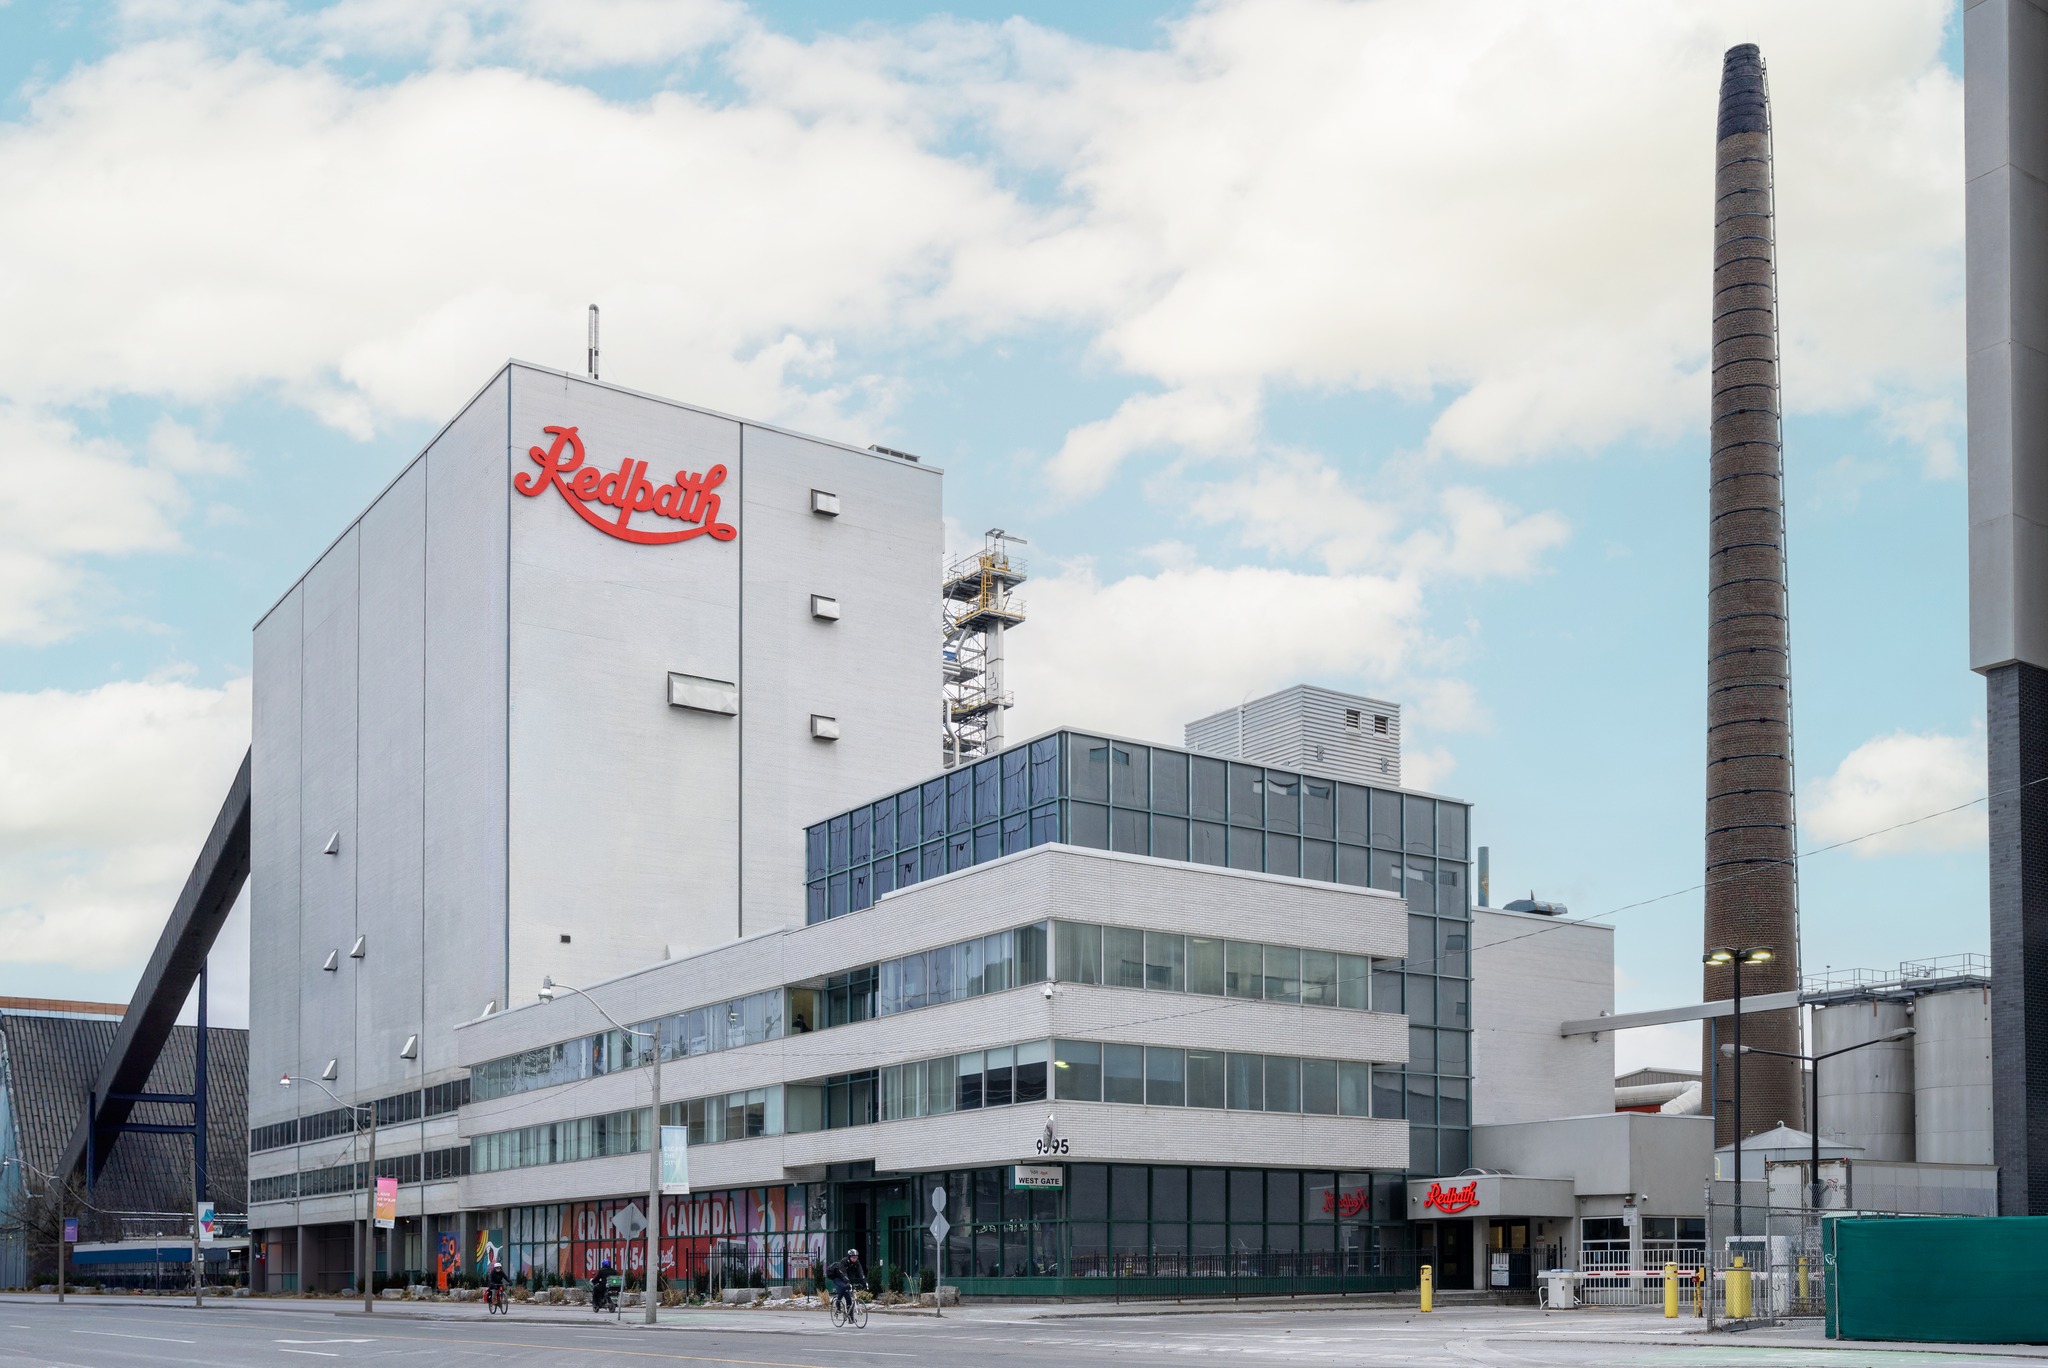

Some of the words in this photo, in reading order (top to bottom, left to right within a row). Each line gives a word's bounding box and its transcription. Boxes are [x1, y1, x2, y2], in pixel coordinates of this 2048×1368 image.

[514, 425, 737, 545] Redpath
[1423, 1181, 1480, 1214] Redpath
[667, 1200, 737, 1237] CANADA
